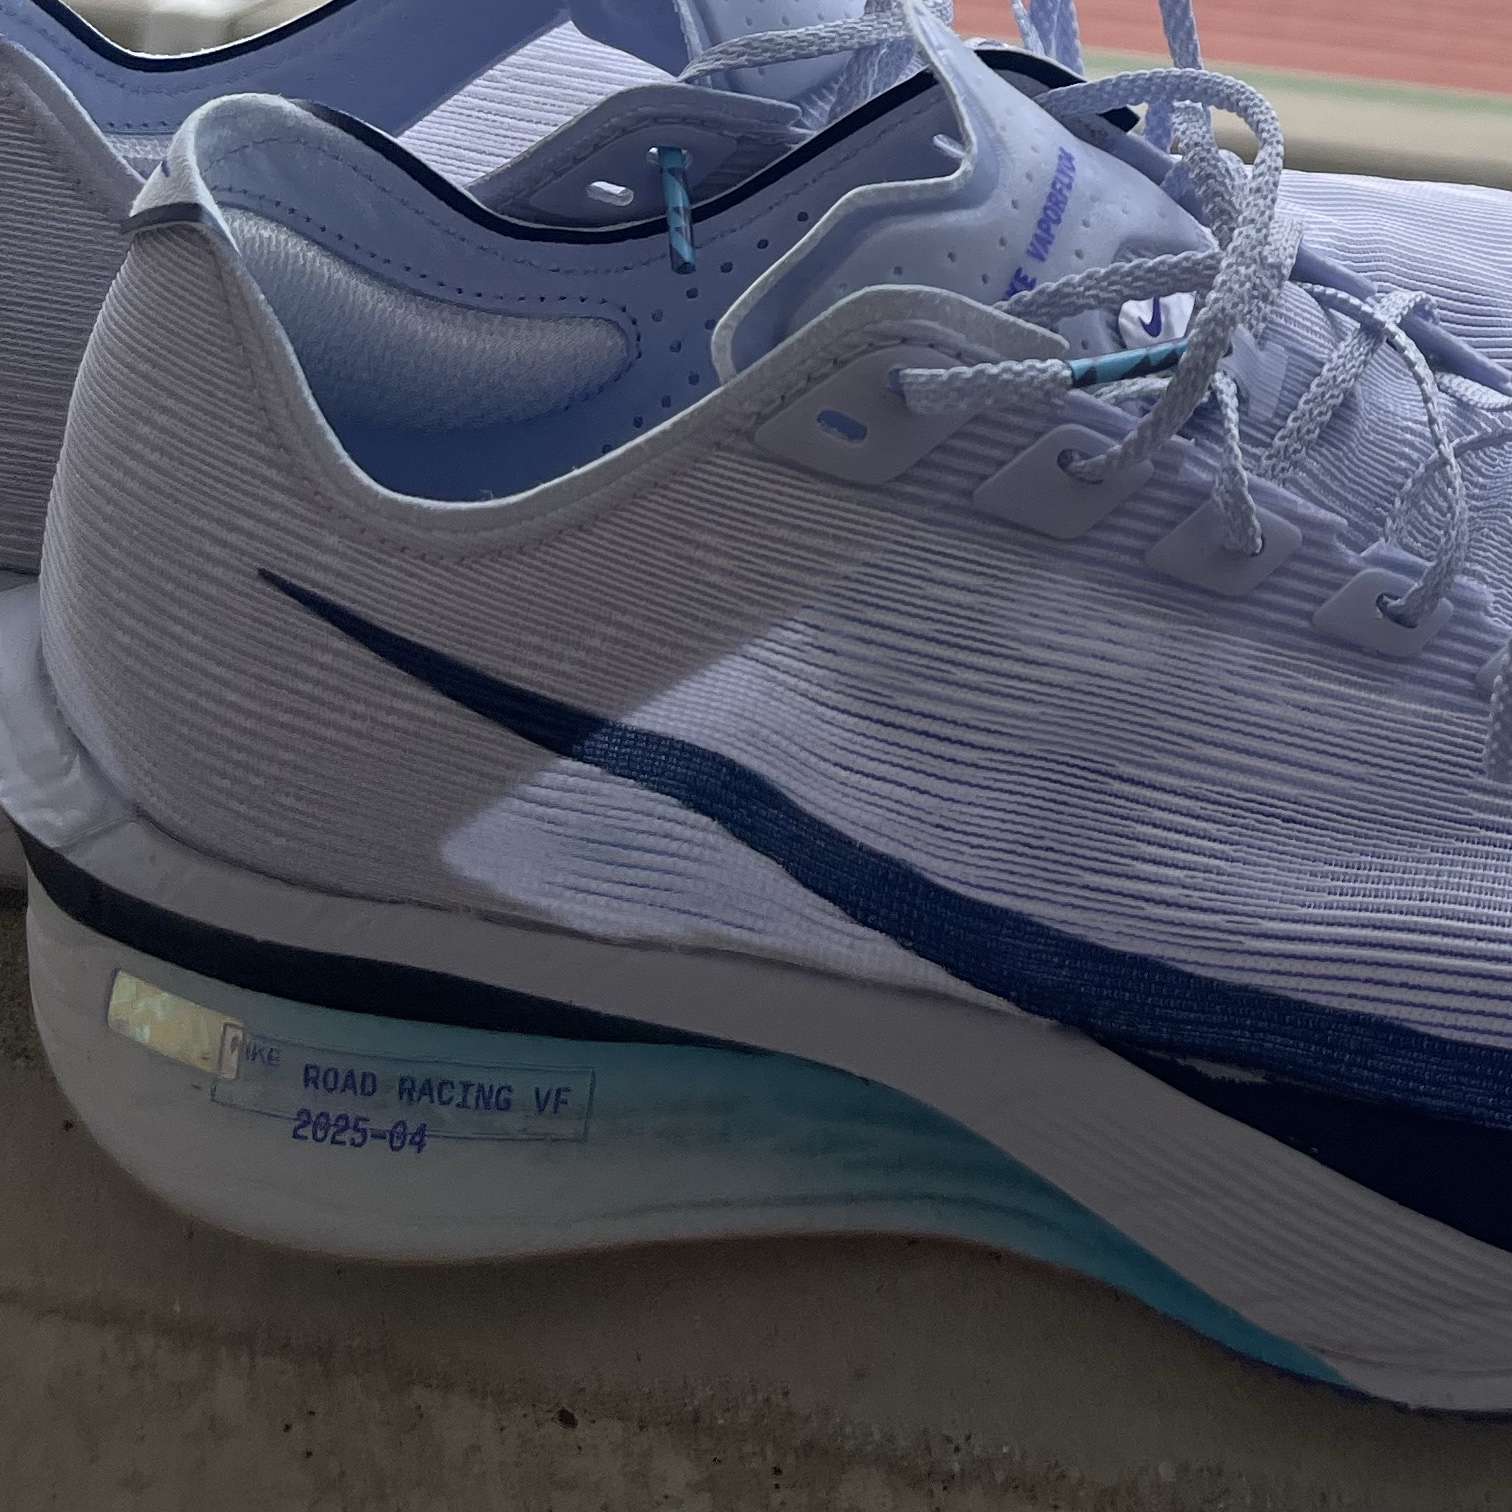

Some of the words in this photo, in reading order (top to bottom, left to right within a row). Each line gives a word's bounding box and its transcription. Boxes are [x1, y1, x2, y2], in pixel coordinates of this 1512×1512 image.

[242, 1040, 281, 1067] IKE
[302, 1062, 378, 1097] ROAD
[397, 1074, 514, 1112] RACING
[533, 1086, 572, 1115] VF
[291, 1106, 428, 1154] 2025-04
